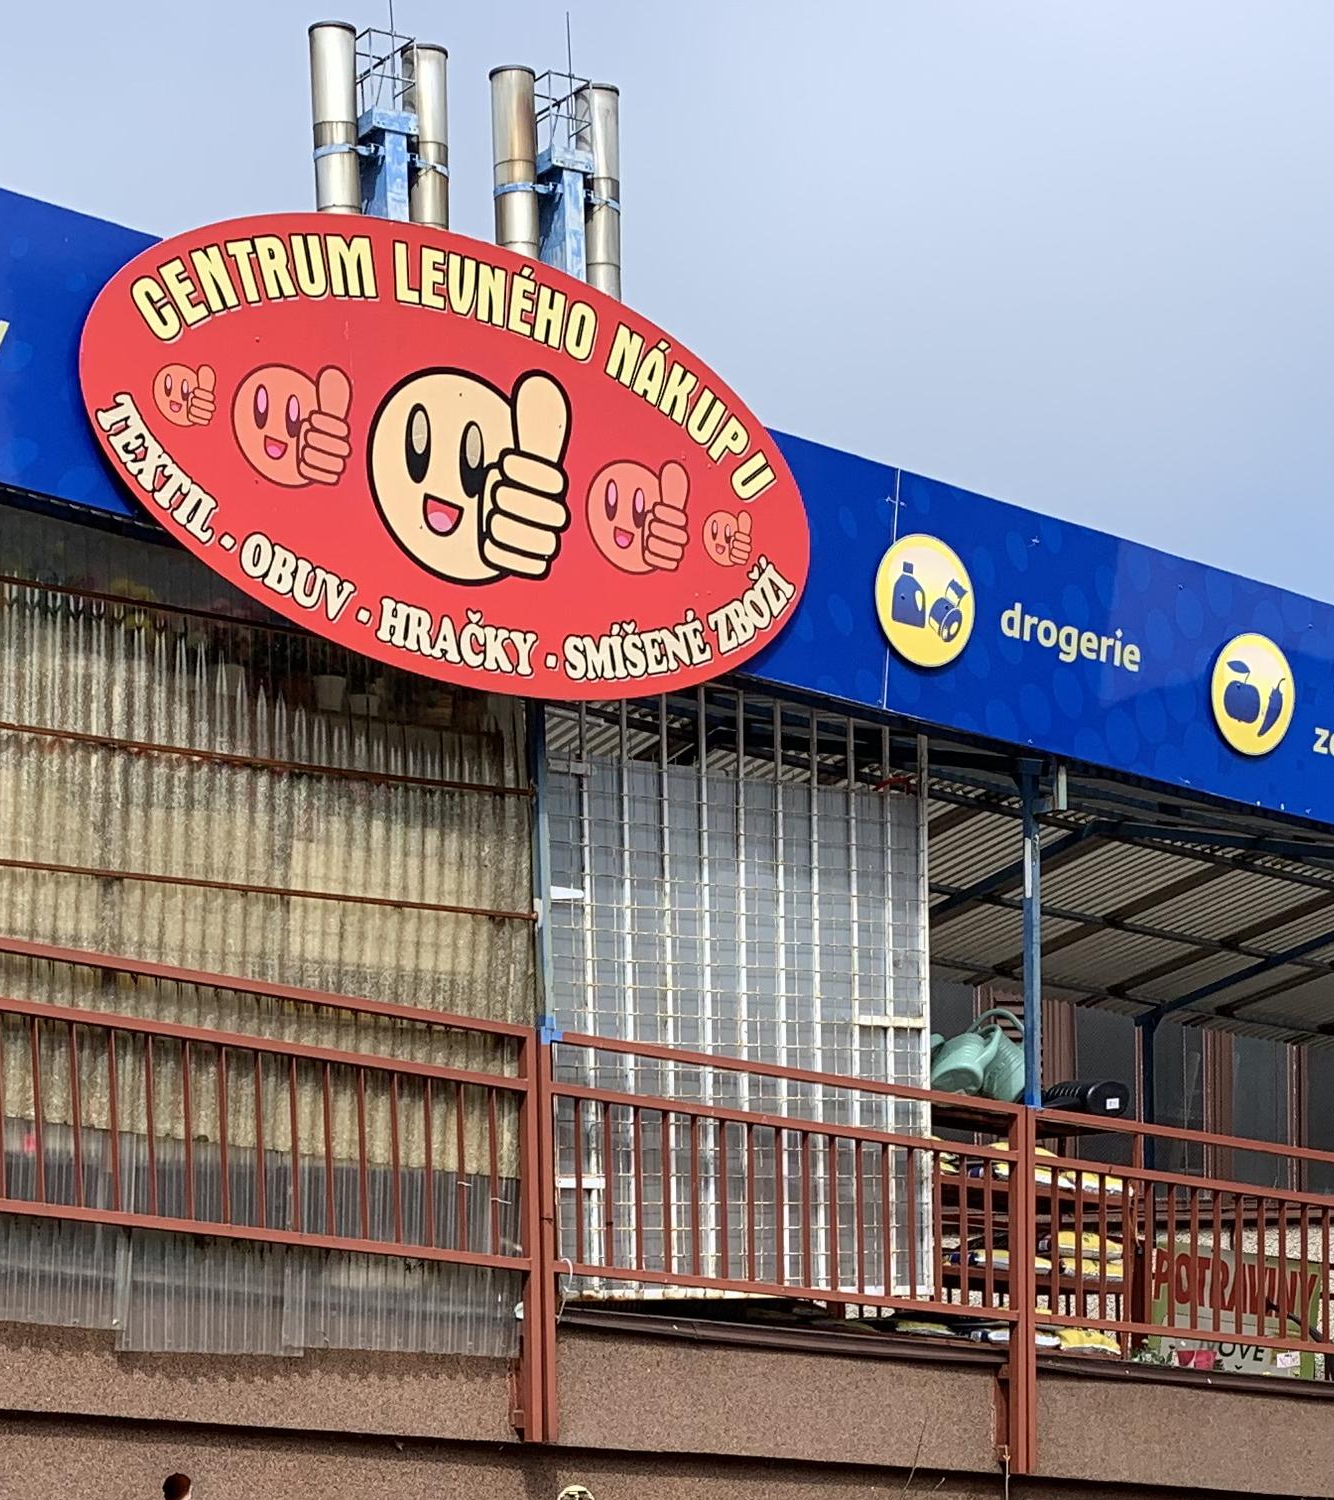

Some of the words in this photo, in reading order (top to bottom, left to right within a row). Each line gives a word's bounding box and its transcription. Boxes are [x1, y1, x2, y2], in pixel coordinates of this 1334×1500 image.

[130, 233, 378, 342] CENTRUM
[394, 241, 597, 363] LEVNÉHO
[95, 392, 218, 545] TEXTIL
[240, 531, 356, 622] OBUV
[375, 609, 537, 678] HRAČKY
[564, 608, 713, 681] SMÍŠENÉ
[707, 554, 796, 656] ZBOŽÍ
[1000, 602, 1141, 673] drogerie
